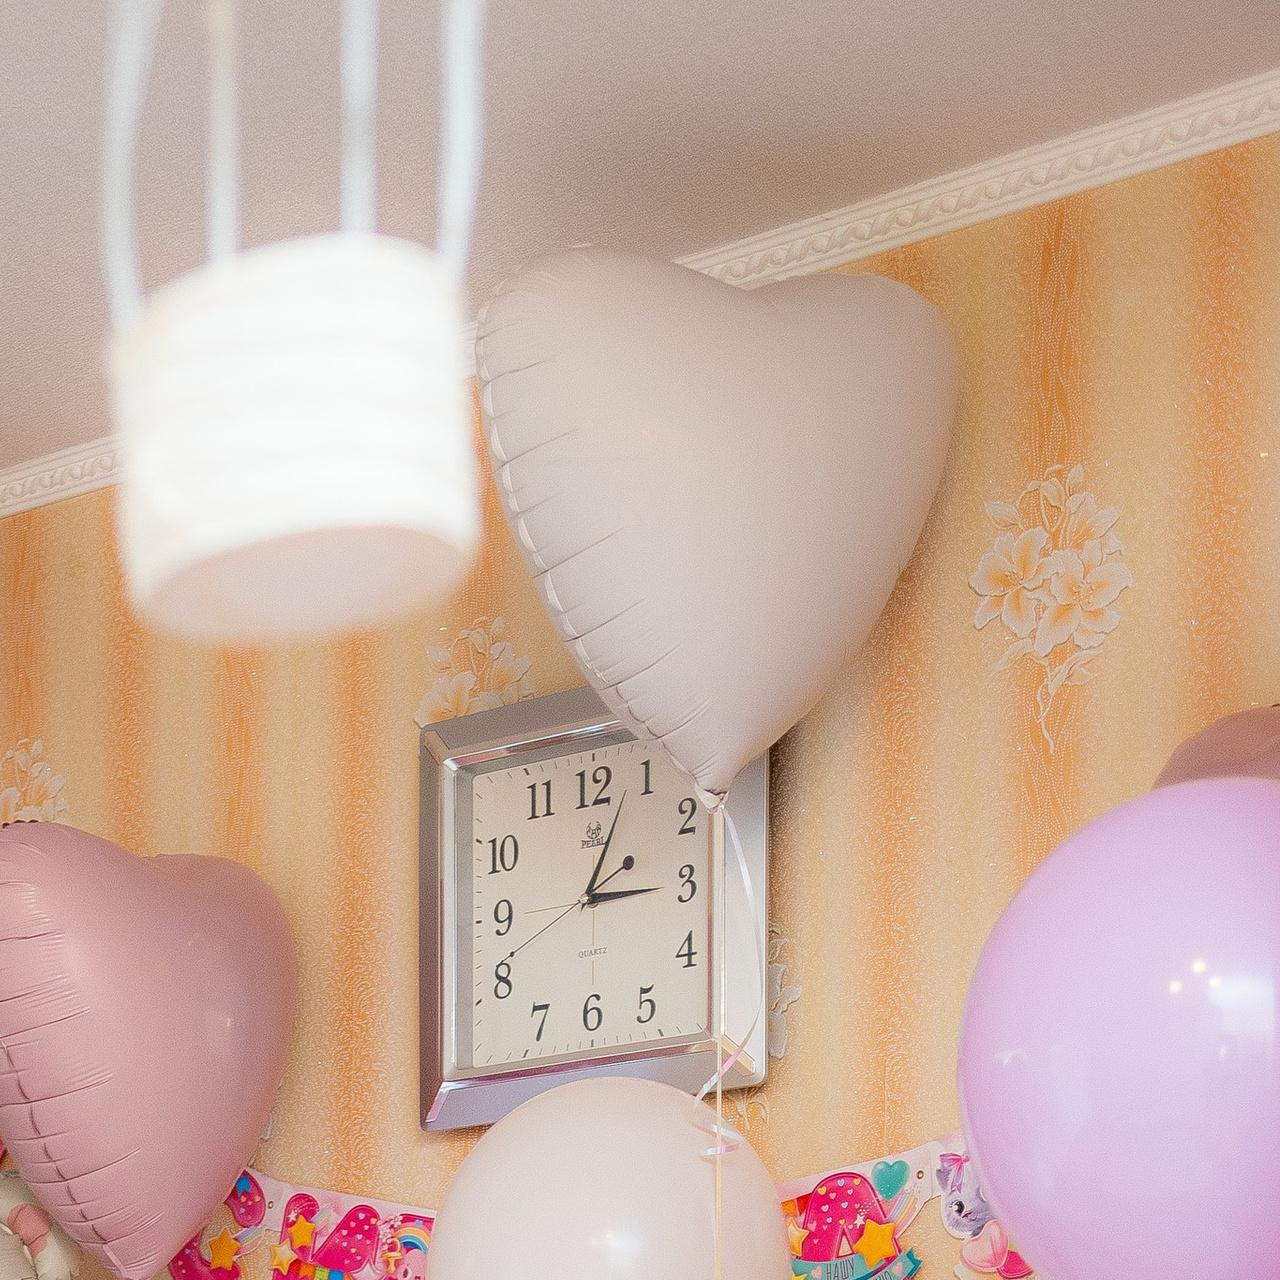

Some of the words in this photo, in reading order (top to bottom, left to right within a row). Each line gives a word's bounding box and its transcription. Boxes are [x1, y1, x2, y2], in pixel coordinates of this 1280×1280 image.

[575, 765, 612, 810] 12
[640, 759, 654, 796] 1
[526, 779, 556, 821] 11
[677, 797, 697, 836] 2
[487, 834, 519, 875] 10
[677, 864, 697, 903] 3
[493, 899, 513, 937] 9
[578, 946, 608, 959] QUARTZ
[675, 929, 698, 969] 4
[493, 961, 513, 1000] 8
[531, 1001, 551, 1042] 7
[582, 993, 603, 1032] 6
[636, 984, 656, 1024] 5
